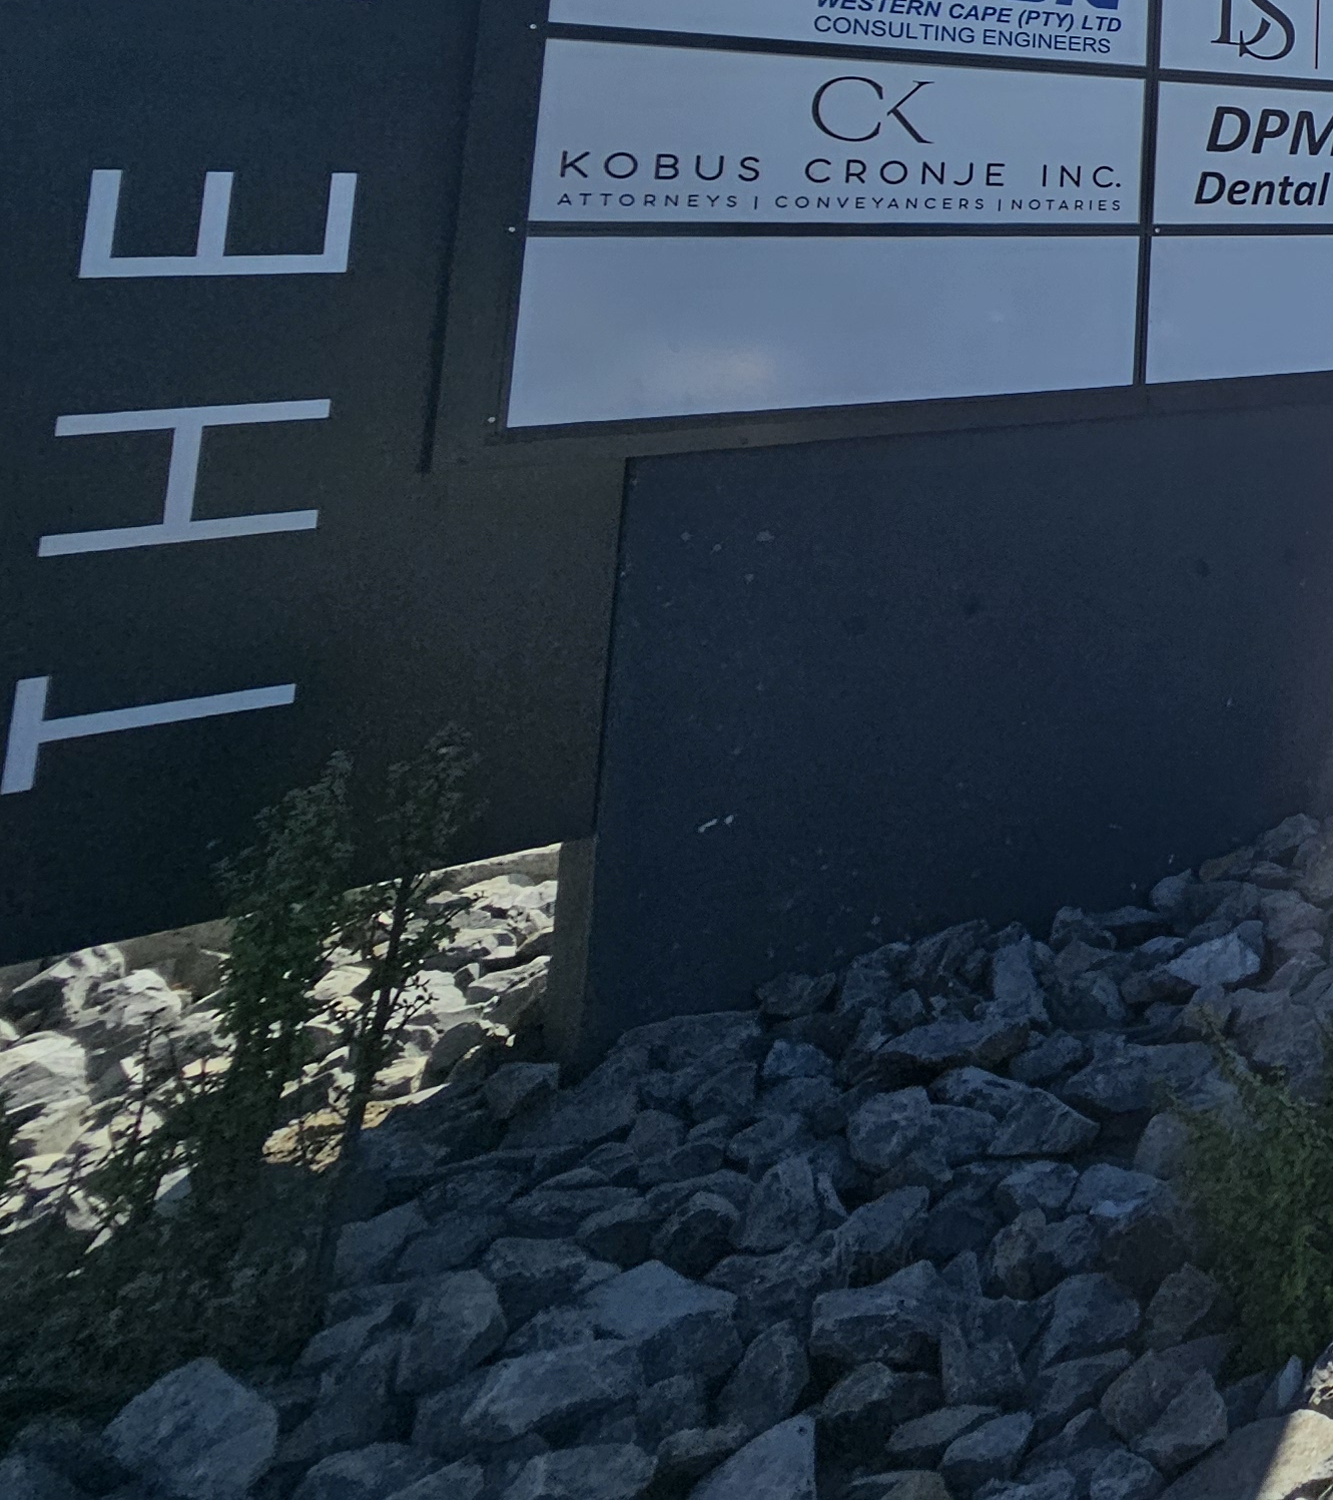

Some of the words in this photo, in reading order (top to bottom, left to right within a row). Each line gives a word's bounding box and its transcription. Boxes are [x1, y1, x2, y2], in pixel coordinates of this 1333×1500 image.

[813, 15, 976, 45] CONSULTING
[982, 28, 1112, 55] ENGINEERS
[949, 2, 1011, 24] CAPE
[1017, 7, 1076, 33] (PTY)
[1081, 15, 1122, 33] LTD
[811, 76, 935, 145] CK
[559, 150, 761, 182] KOBUS
[804, 158, 1006, 188] CRONJE
[1041, 164, 1122, 189] INC.
[1194, 171, 1331, 206] Dental
[556, 192, 738, 209] ATTORNEYS
[775, 194, 985, 211] CONVEYANCERS
[1010, 199, 1122, 212] NOTARIES
[2, 168, 361, 795] THE
